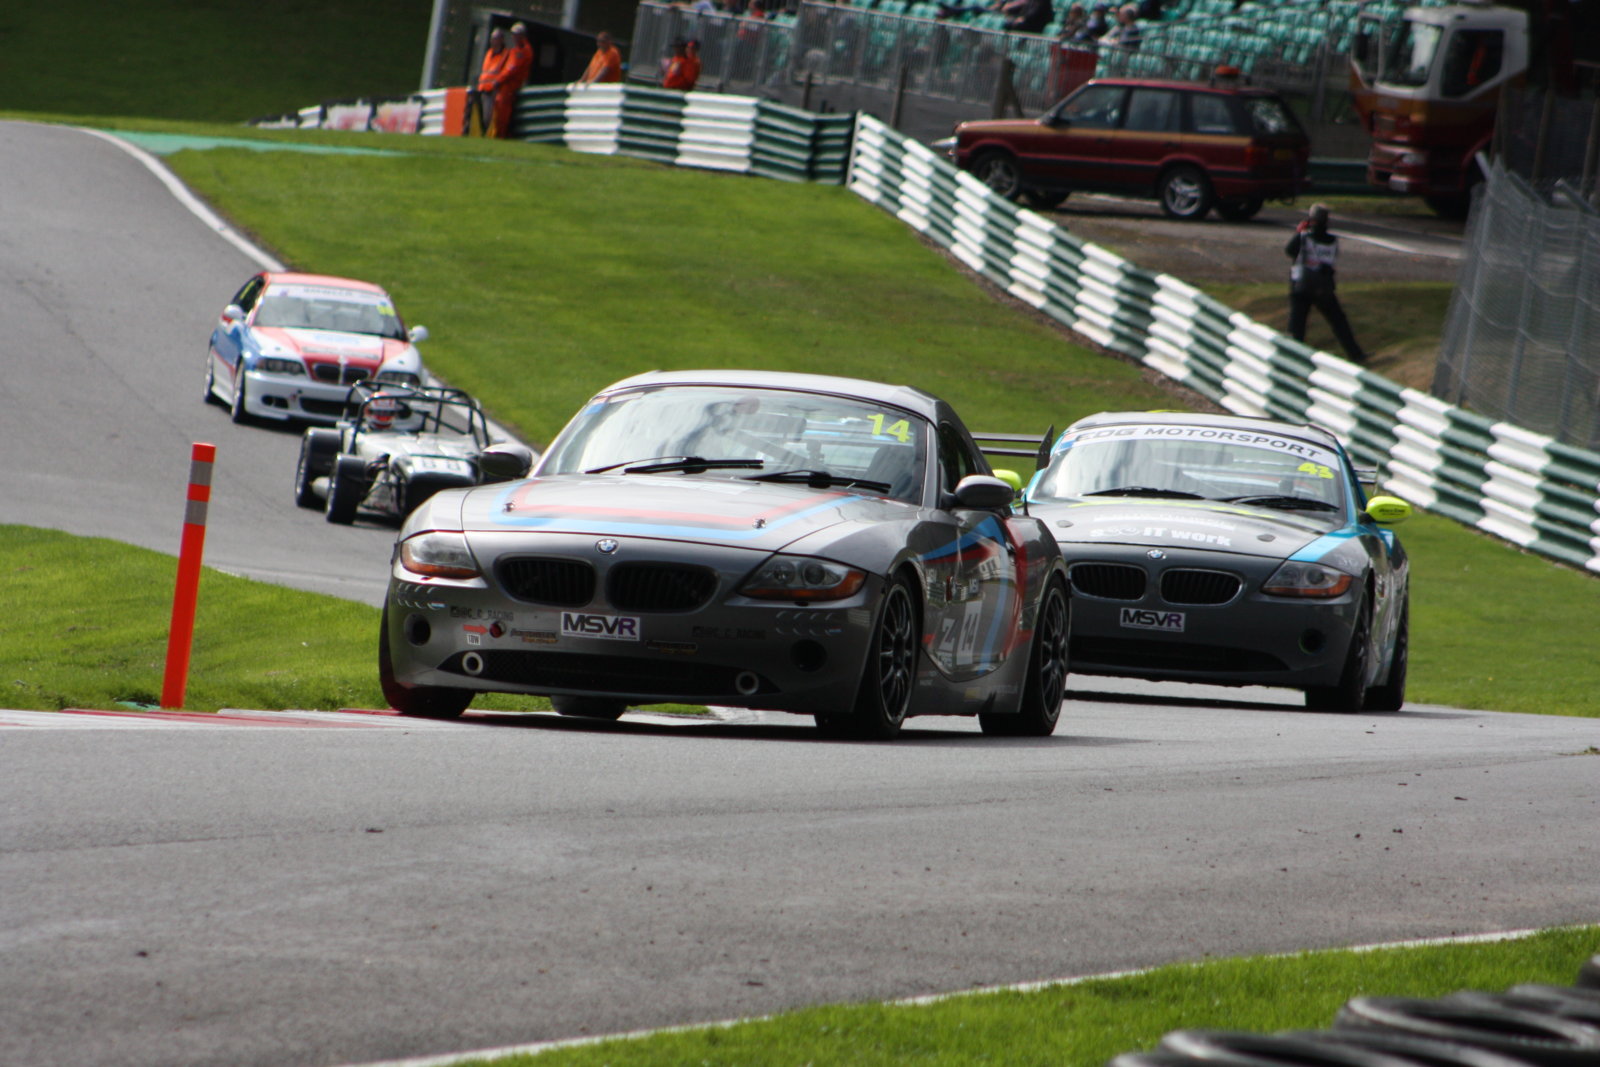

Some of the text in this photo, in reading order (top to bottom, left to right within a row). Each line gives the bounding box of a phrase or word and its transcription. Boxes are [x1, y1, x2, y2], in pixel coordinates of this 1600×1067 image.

[867, 412, 912, 443] 14
[1144, 427, 1322, 459] MOTORSPORT
[1297, 461, 1334, 480] 43
[1171, 529, 1232, 547] work
[564, 612, 636, 636] MSVR
[1123, 608, 1182, 628] MSVR
